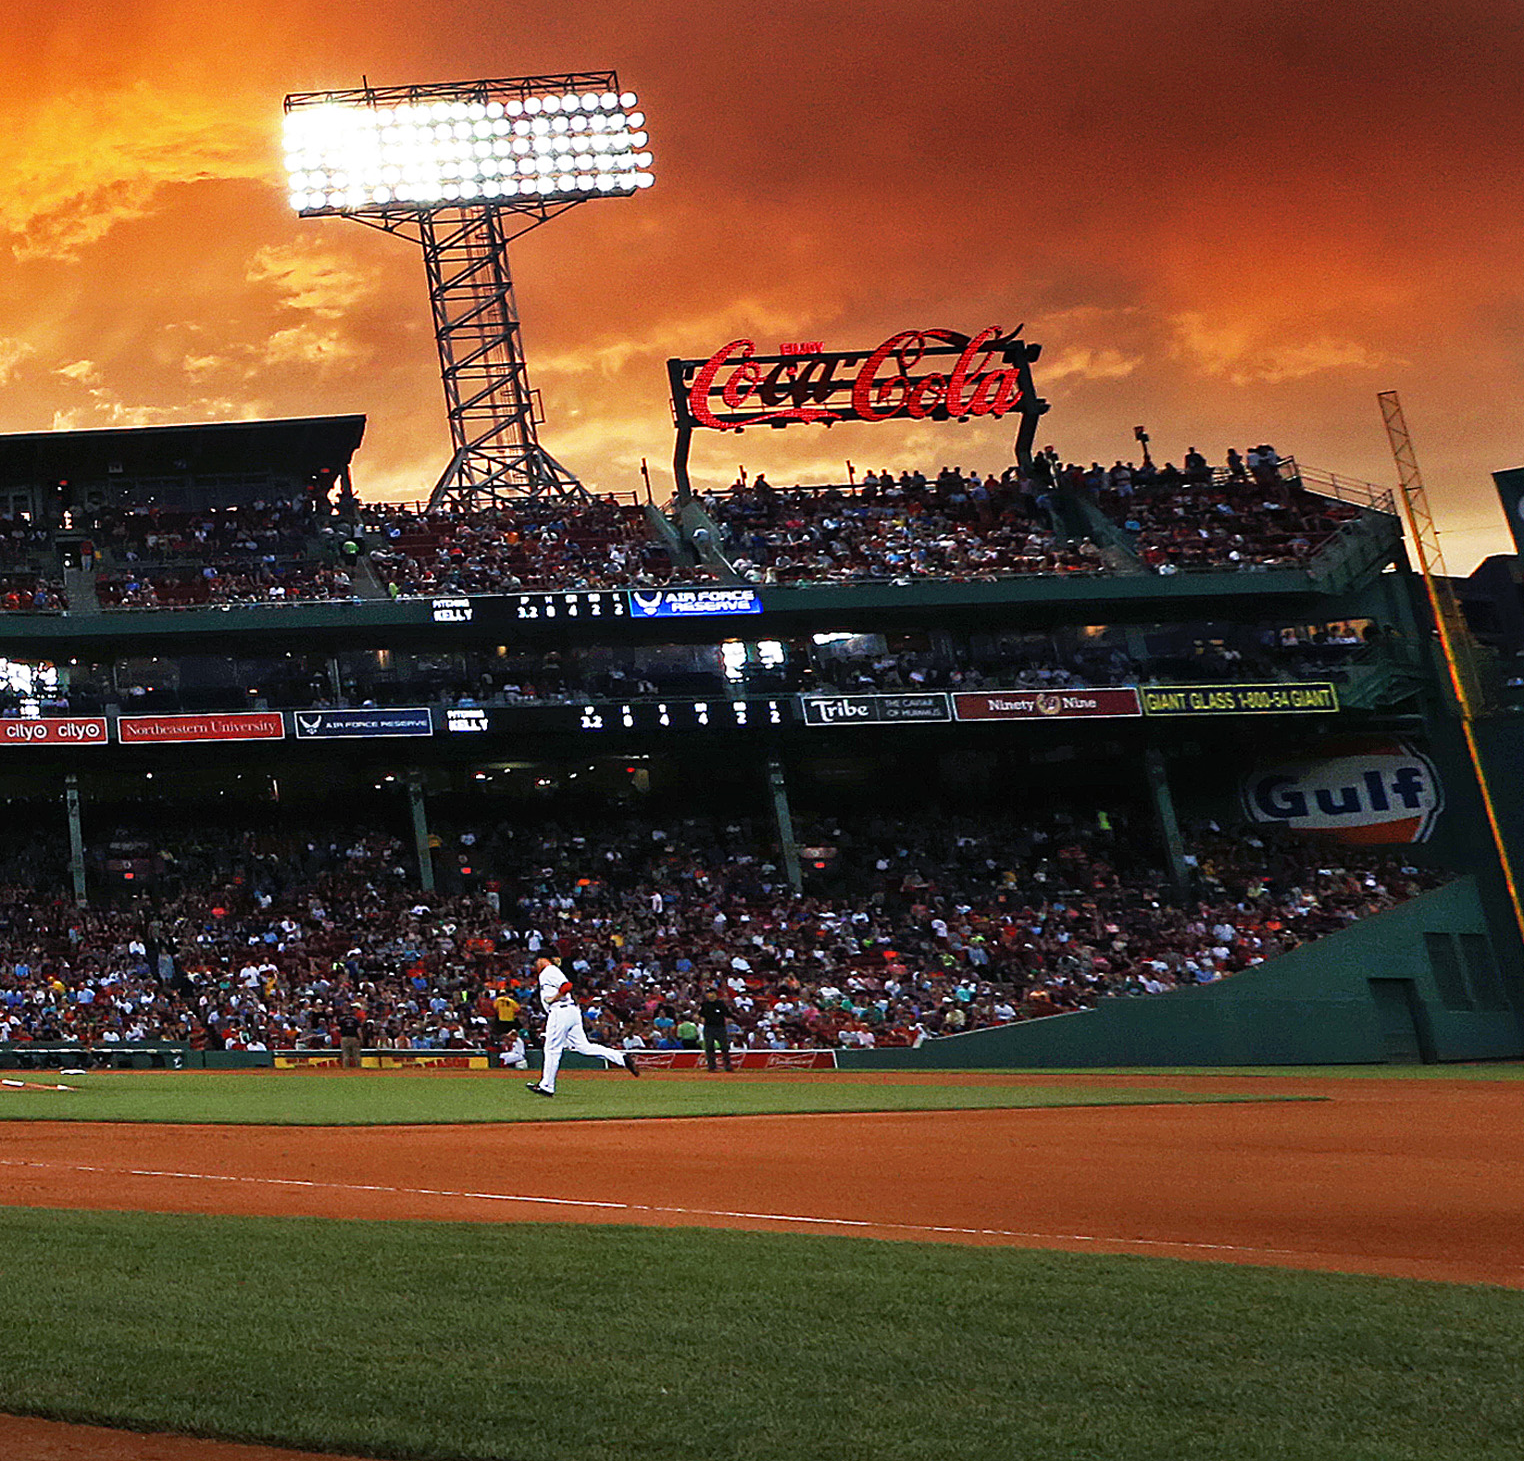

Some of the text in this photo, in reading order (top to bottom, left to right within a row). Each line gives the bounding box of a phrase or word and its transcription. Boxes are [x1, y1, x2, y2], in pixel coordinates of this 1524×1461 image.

[665, 590, 755, 603] AIR FORCE
[433, 608, 473, 622] KELLY
[517, 606, 538, 618] 3.2
[568, 604, 578, 617] 4
[591, 603, 602, 616] 2
[614, 603, 624, 616] 2
[672, 601, 752, 613] RESERVE
[988, 698, 1035, 712] Ninety
[1062, 697, 1097, 709] Nine
[1146, 692, 1186, 711] GIANT
[1190, 691, 1236, 710] GLASS
[1290, 689, 1331, 708] GIANT
[811, 699, 870, 722] Tribe
[126, 720, 277, 737] Northeastern University
[325, 719, 428, 729] AIR FORCE RESERVE
[448, 718, 489, 732] KELLY
[735, 711, 747, 725] 2
[770, 710, 781, 724] 2
[1253, 767, 1424, 819] Gulf
